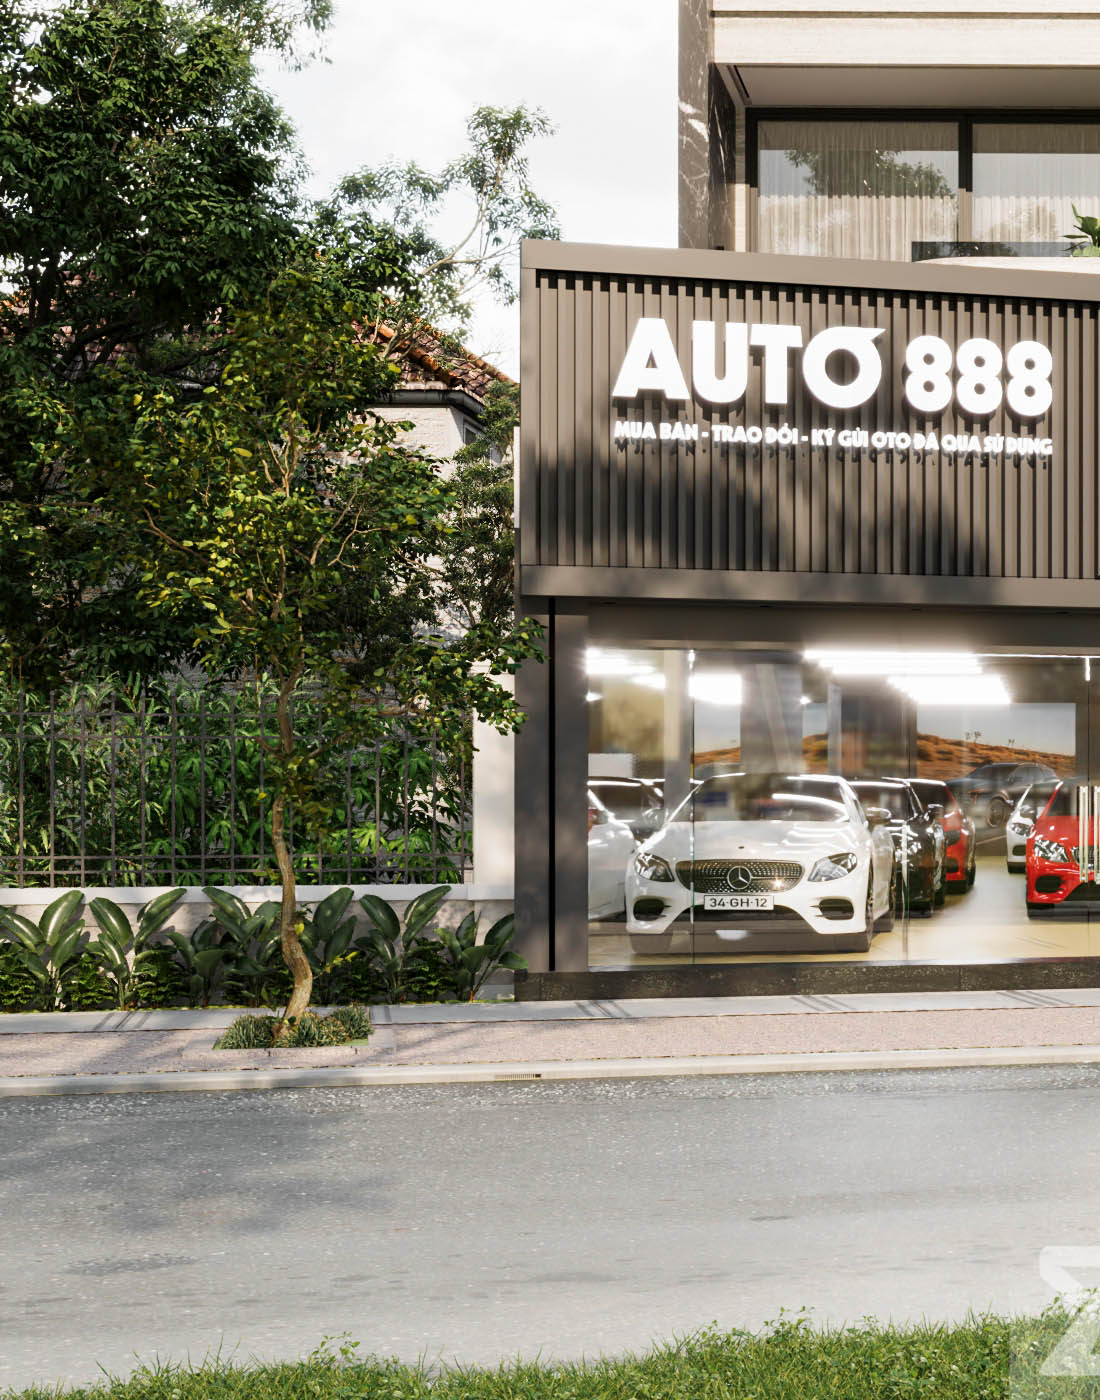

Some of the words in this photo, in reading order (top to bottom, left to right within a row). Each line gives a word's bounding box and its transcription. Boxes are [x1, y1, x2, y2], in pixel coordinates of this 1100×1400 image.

[905, 335, 1053, 416] 888
[614, 421, 657, 439] MUA
[711, 424, 763, 444] TRAO
[941, 433, 982, 453] QUA
